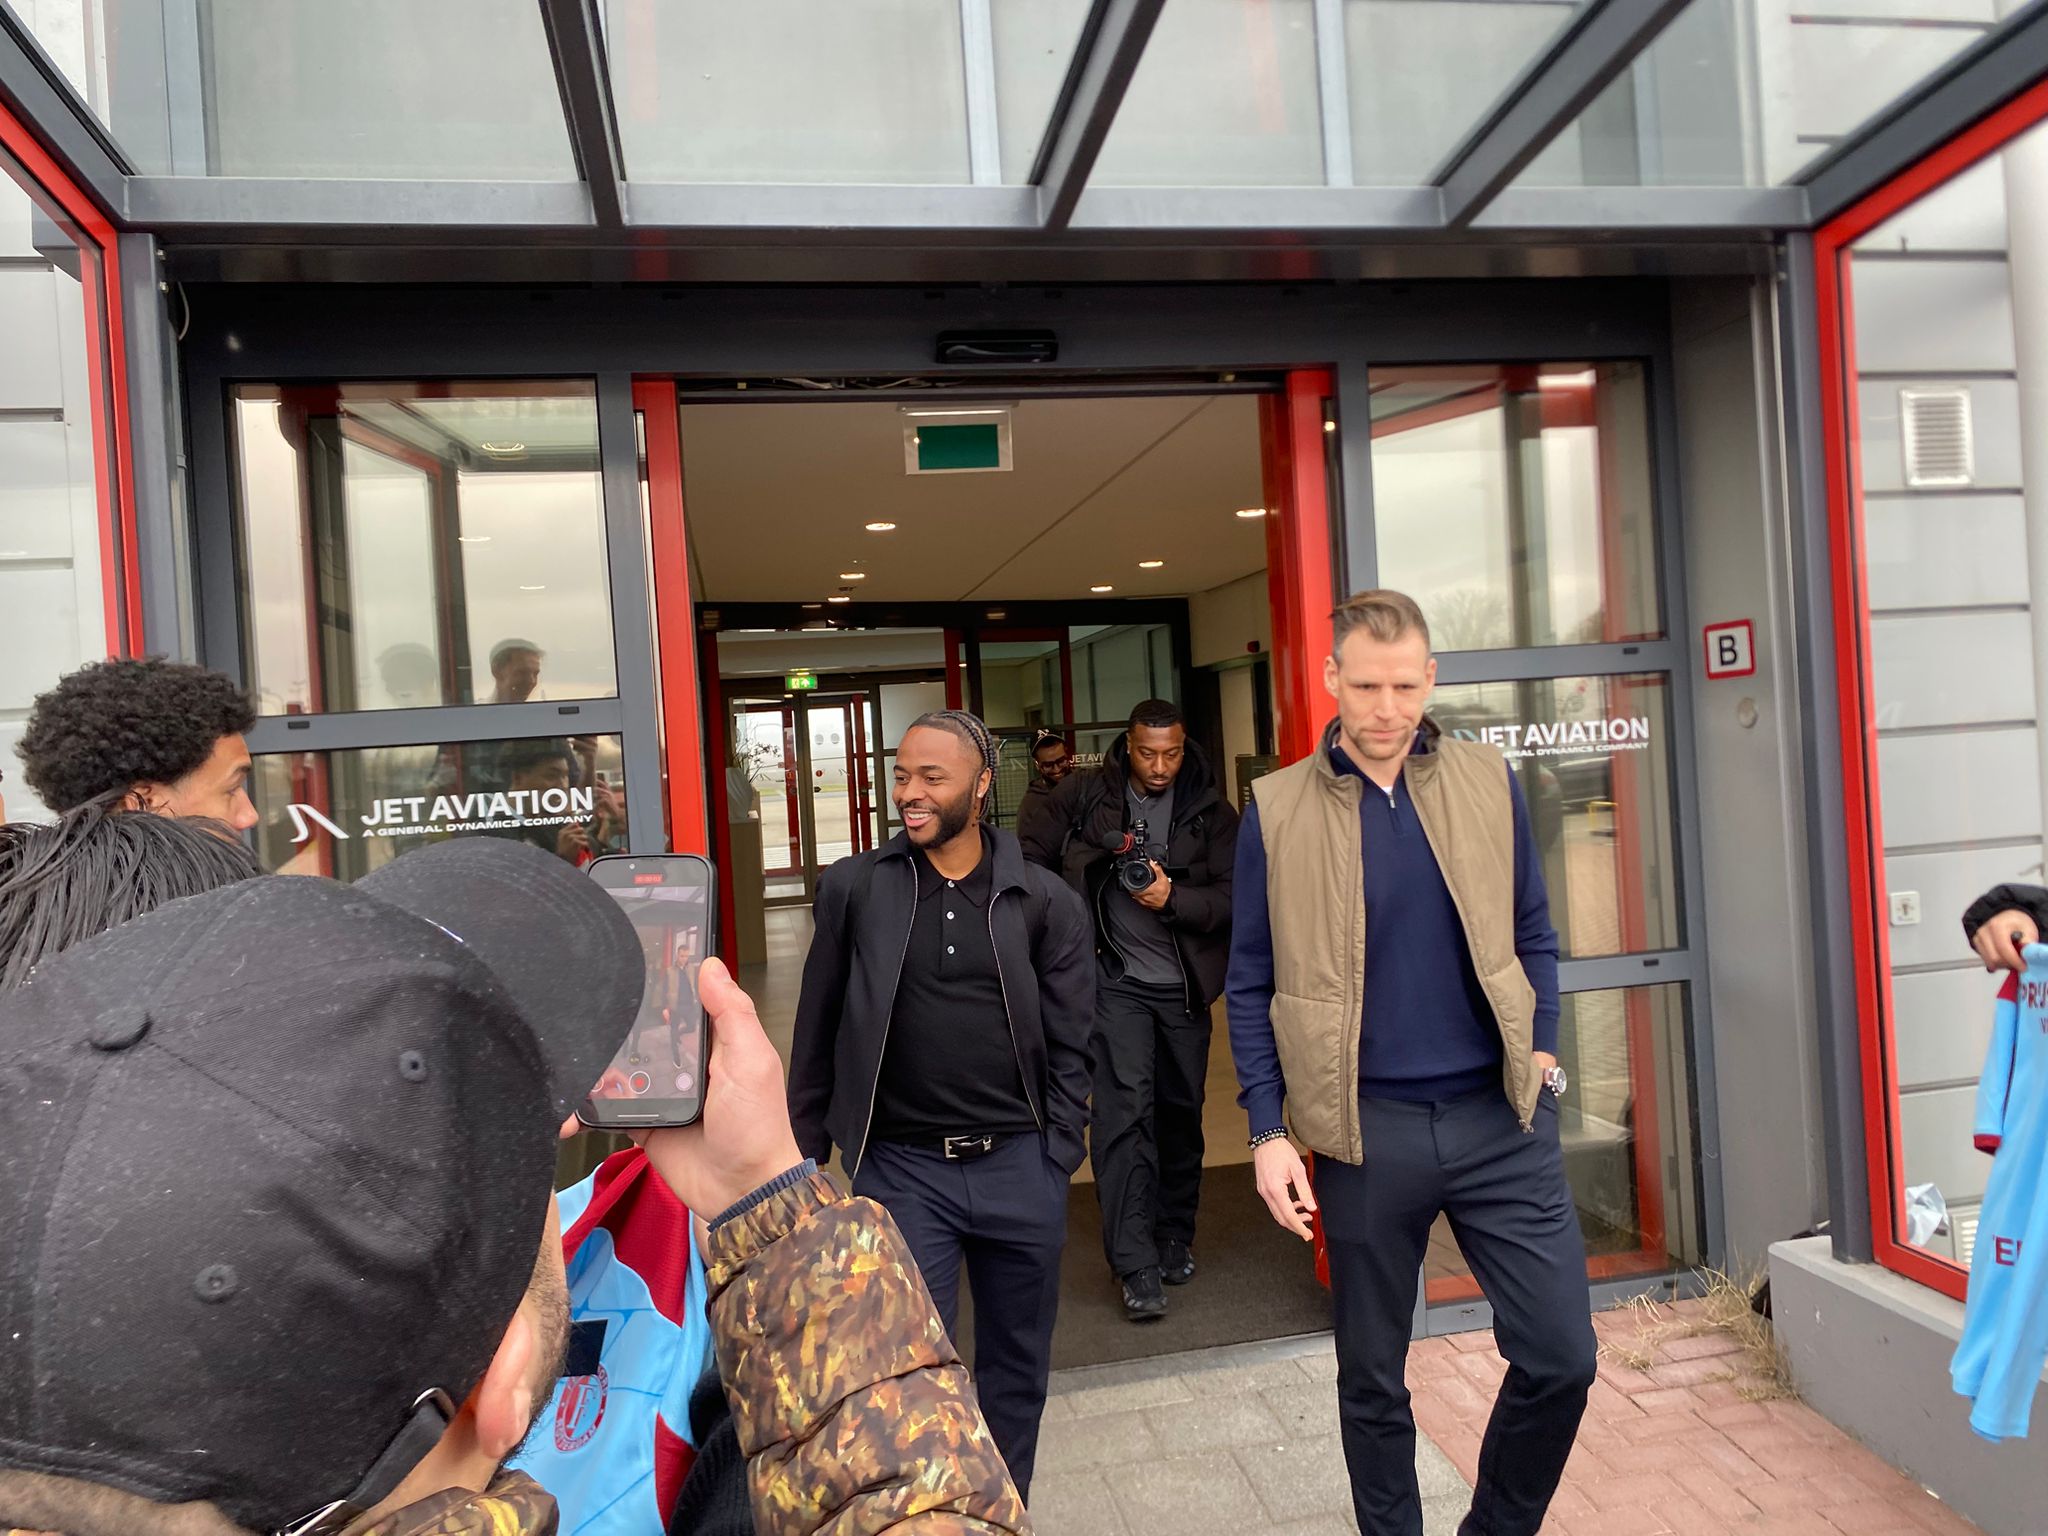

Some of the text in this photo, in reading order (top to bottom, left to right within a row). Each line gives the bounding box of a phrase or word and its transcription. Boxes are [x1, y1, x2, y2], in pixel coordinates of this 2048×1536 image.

[1718, 635, 1738, 667] B
[1523, 717, 1649, 747] AVIATION
[1070, 752, 1106, 763] JET AVI
[1536, 745, 1594, 756] DYNAMICS
[1595, 742, 1649, 751] COMPANY
[361, 787, 593, 825] JET AVIATION
[362, 814, 594, 838] A GENERAL DYNAMICS COMPANY
